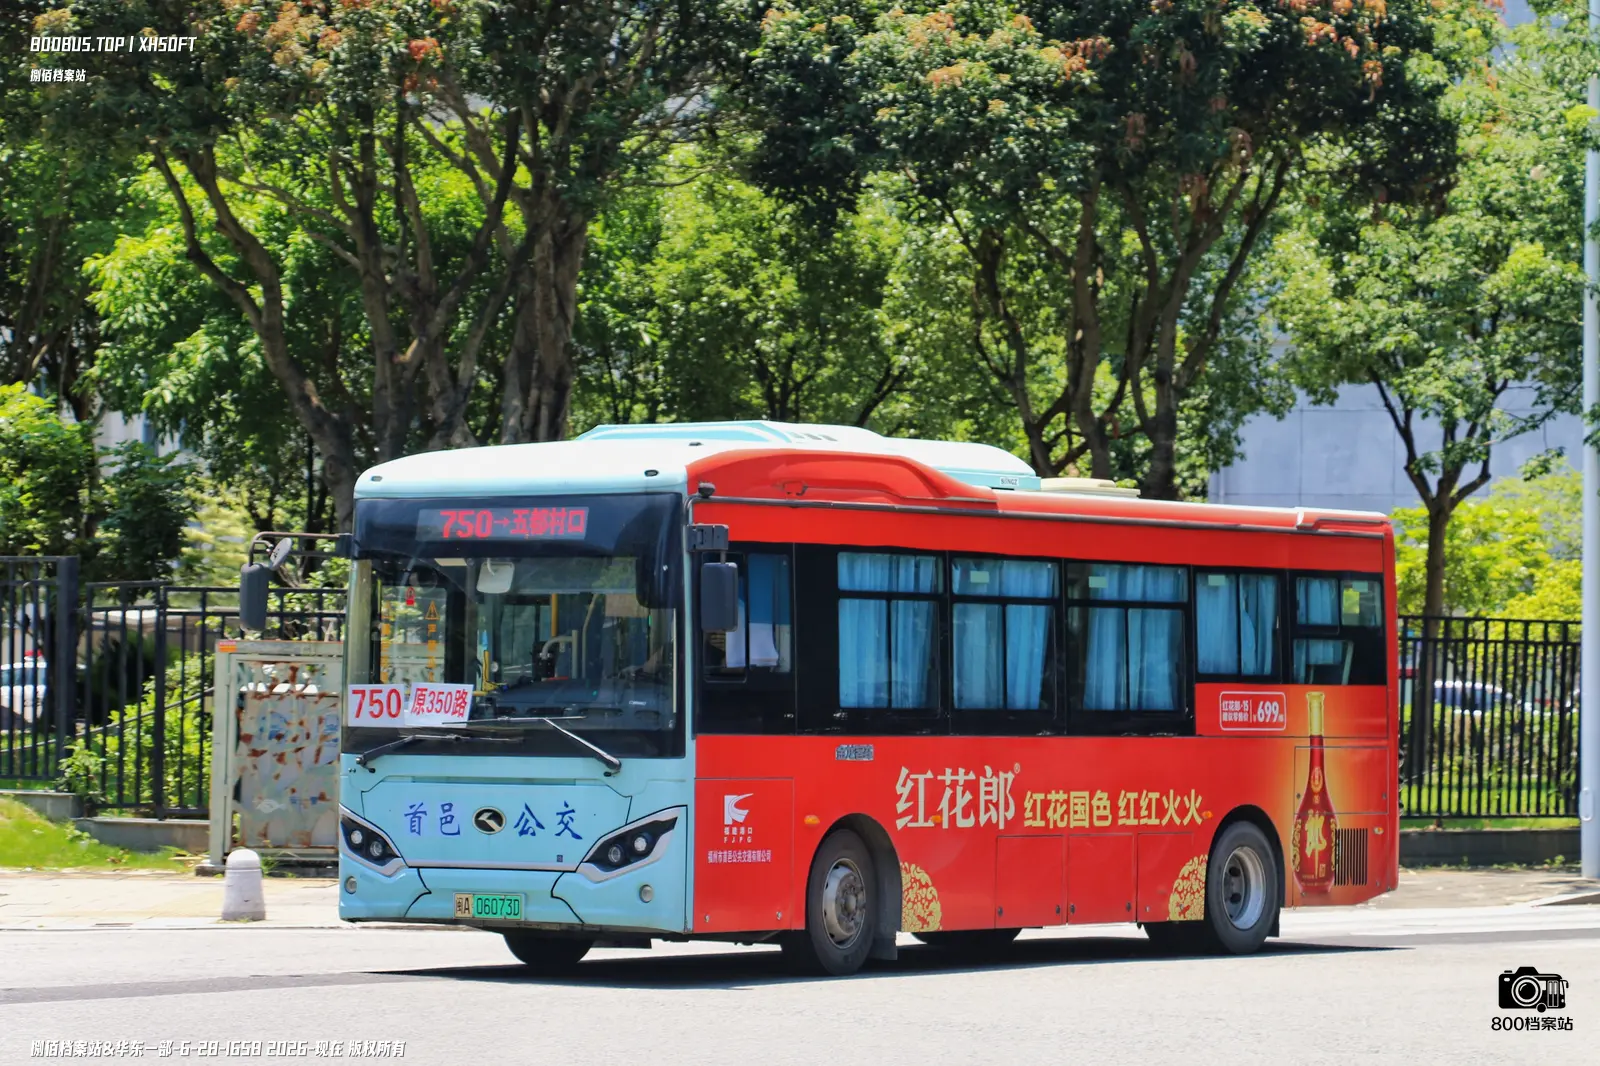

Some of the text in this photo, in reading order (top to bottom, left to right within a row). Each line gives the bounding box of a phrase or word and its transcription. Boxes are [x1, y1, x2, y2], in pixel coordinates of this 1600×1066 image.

[440, 507, 585, 539] 750 五都村口
[351, 688, 402, 719] 750
[411, 687, 468, 718] 原350路
[895, 766, 1017, 830] 红花郎
[1023, 789, 1203, 829] 红花国色 红红火火
[404, 801, 583, 840] 首邑 公交
